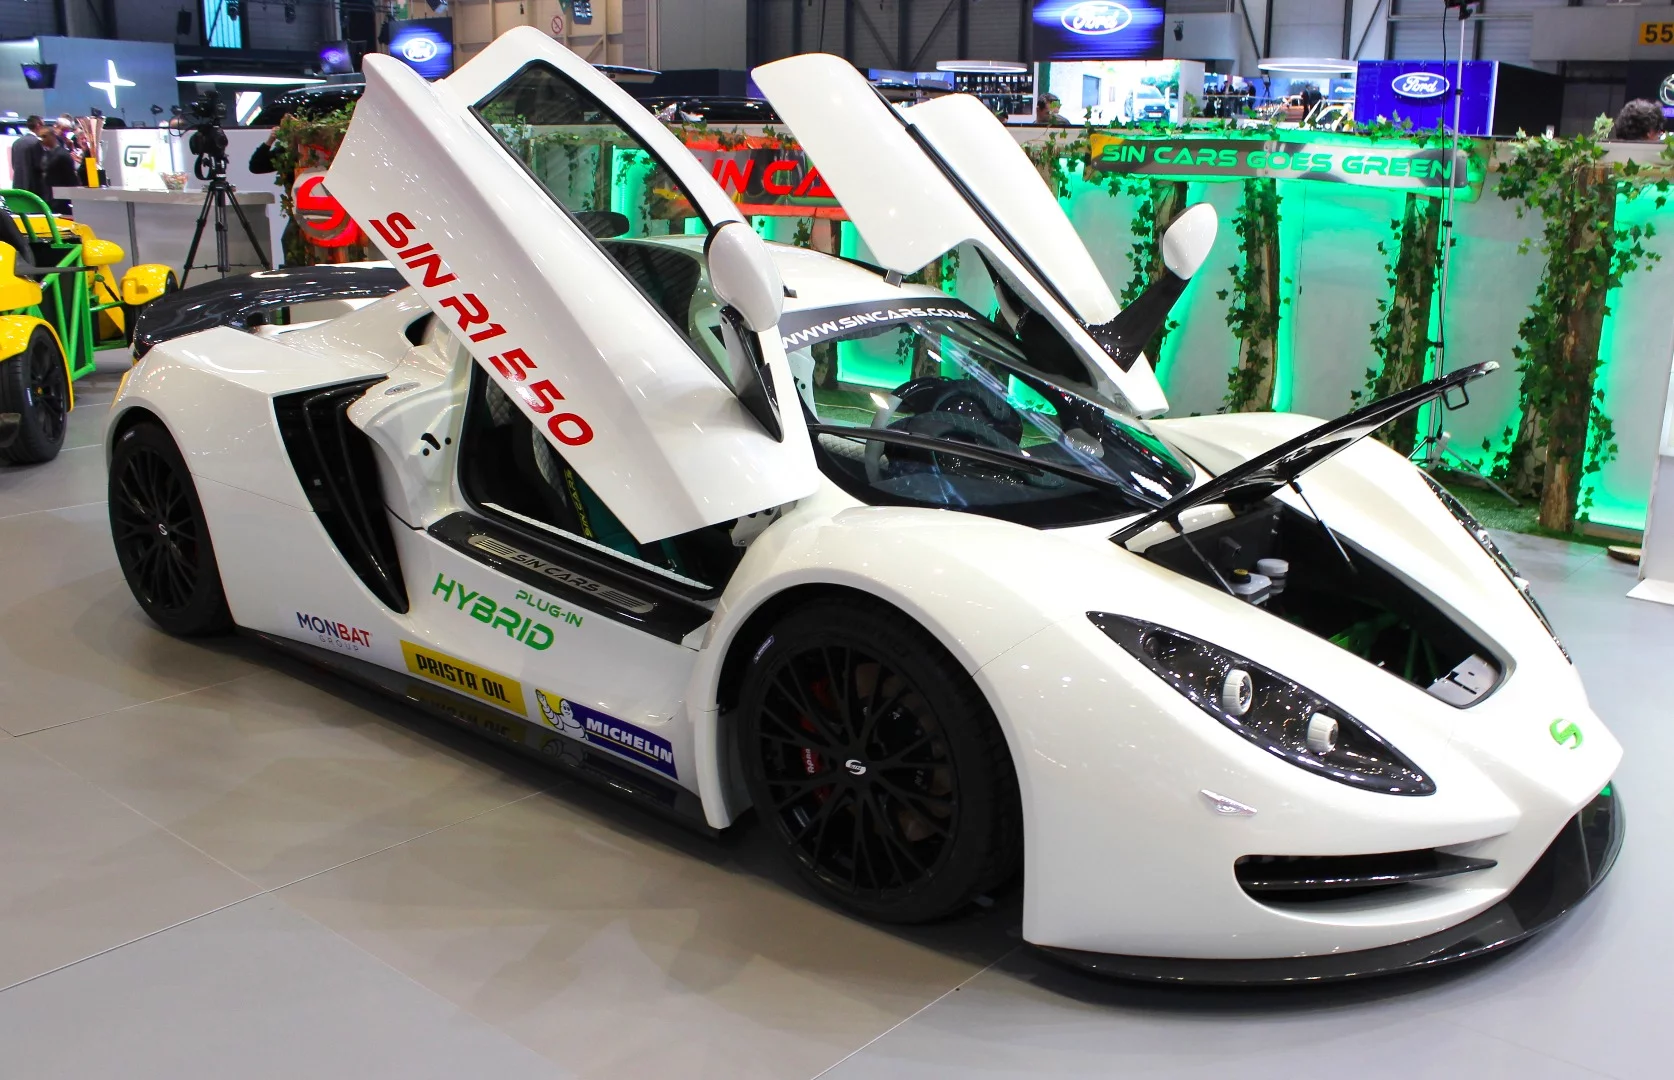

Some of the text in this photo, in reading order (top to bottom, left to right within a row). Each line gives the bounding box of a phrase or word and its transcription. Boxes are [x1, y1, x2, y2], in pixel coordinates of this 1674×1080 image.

[708, 158, 755, 195] IN
[1101, 144, 1453, 180] SIN CARS GOES GREEN
[369, 212, 594, 446] SIN R1 550
[512, 554, 600, 593] SIN CARS
[432, 573, 555, 651] HYBRID
[515, 589, 584, 628] PLUG-IN
[296, 611, 371, 648] MONBAT
[319, 634, 359, 651] GROUP
[415, 653, 511, 704] PRISTA OIL
[586, 717, 673, 764] MICHELIN
